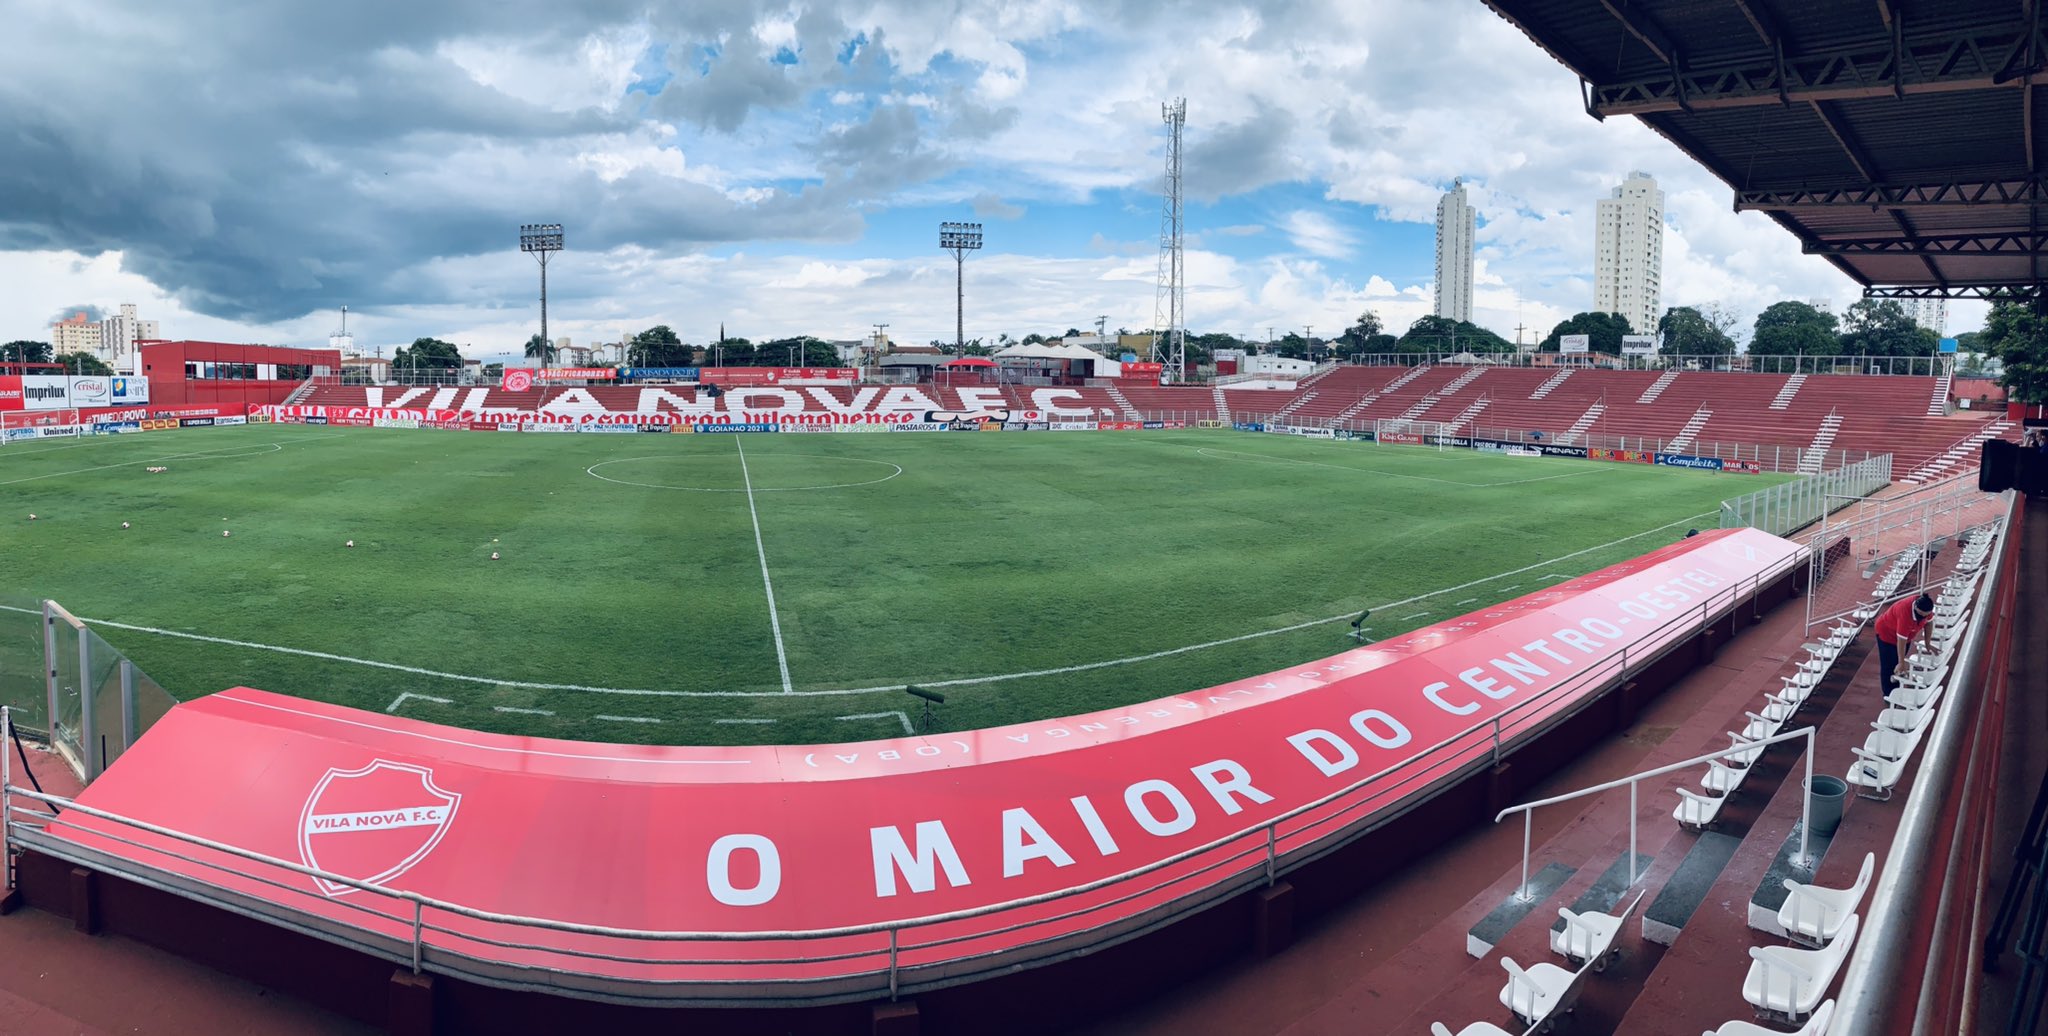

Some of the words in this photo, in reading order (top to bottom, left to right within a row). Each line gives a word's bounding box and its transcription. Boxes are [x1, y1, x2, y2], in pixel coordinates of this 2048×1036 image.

[24, 384, 65, 402] Imprilux
[78, 381, 103, 391] cristal
[637, 387, 944, 411] NOVA
[44, 427, 74, 436] Unimed
[896, 423, 937, 431] PASTAROSA
[1546, 447, 1586, 455] PENALTY
[1007, 682, 1278, 744] ALVARENGA
[706, 833, 782, 906] O
[870, 759, 1276, 898] MAIOR
[1286, 708, 1413, 778] DO
[1422, 567, 1726, 716] CENTRO-OESTE!
[804, 740, 970, 767] (OBA)
[313, 817, 350, 830] VILA
[356, 812, 407, 827] NOVA
[413, 809, 441, 822] F.C.
